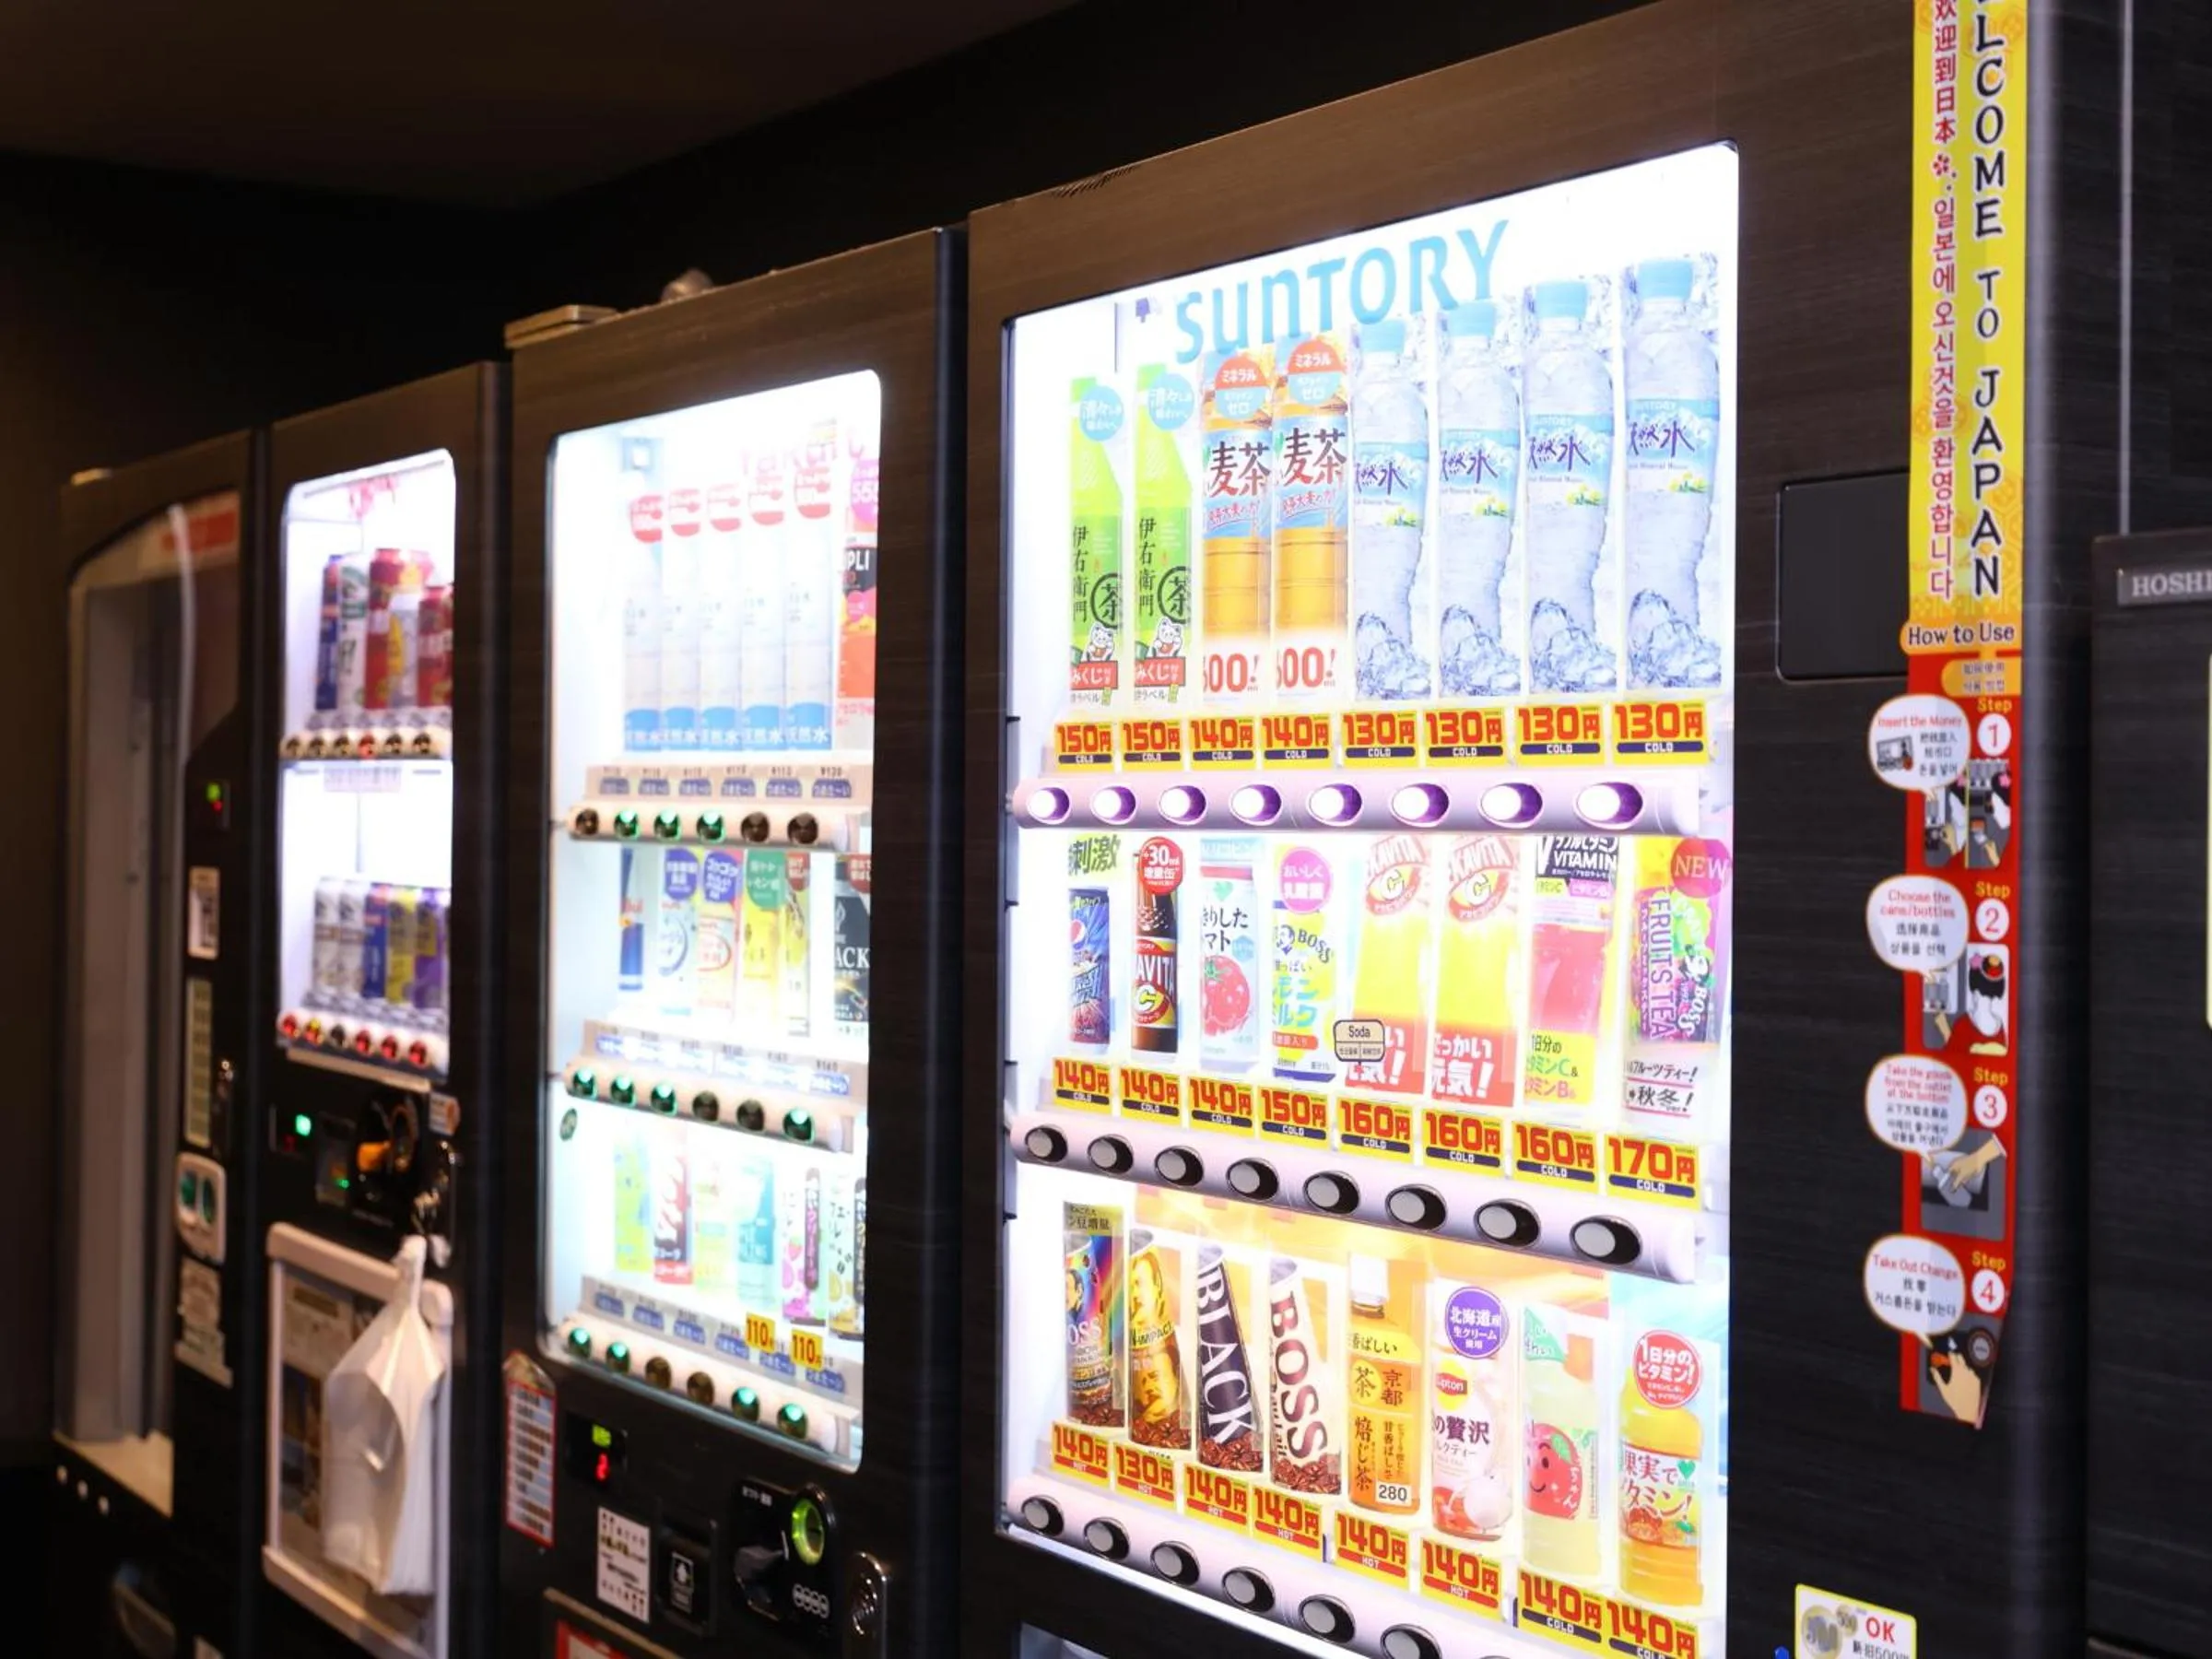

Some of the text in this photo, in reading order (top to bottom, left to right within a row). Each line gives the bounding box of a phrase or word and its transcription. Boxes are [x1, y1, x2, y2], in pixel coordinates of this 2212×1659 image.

[1933, 198, 1955, 293] 일본에
[1175, 219, 1509, 364] SUNTORY
[1971, 0, 2006, 596] LCOME TO JAPAN
[1295, 353, 1331, 367] ミネラル
[1209, 441, 1271, 498] 麦茶
[1283, 428, 1347, 486] 麦茶
[1073, 525, 1088, 623] 伊右衛門
[1138, 518, 1157, 617] 伊右衛門
[1909, 622, 2015, 645] How to Use
[1977, 697, 2012, 713] Step
[1192, 720, 1253, 747] 140円
[1263, 717, 1327, 746] 140円
[1344, 713, 1415, 745] 130円
[1427, 712, 1502, 744] 130円
[1518, 708, 1600, 740] 130円
[1616, 703, 1702, 737] 130円
[1058, 725, 1111, 752] 150円
[1124, 723, 1181, 750] 150円
[1546, 744, 1573, 754] COLD
[1644, 741, 1674, 753] COLD
[1988, 724, 1998, 747] 1
[1076, 754, 1094, 764] COLD
[1142, 753, 1162, 762] COLD
[1211, 751, 1234, 761] COLD
[1285, 750, 1308, 759] COLD
[1368, 747, 1392, 758] COLD
[1453, 747, 1477, 757] COLD
[1283, 865, 1324, 877] おいしく
[1554, 851, 1618, 870] VITAMIN
[1675, 855, 1729, 881] NEW
[1976, 881, 2010, 899] Step
[1984, 907, 2000, 933] 2
[1298, 927, 1331, 964] BOSS
[1651, 897, 1676, 1040] FRUITS TEA
[1348, 1025, 1371, 1038] Soda
[1056, 1061, 1110, 1094] 140円
[1122, 1070, 1179, 1104] 140円
[1974, 1067, 2008, 1085] Step
[1073, 1092, 1092, 1103] COLD
[1141, 1101, 1160, 1113] COLD
[1190, 1079, 1252, 1115] 140円
[1261, 1089, 1326, 1127] 150円
[1983, 1094, 1997, 1119] 3
[1211, 1112, 1232, 1125] COLD
[1282, 1124, 1304, 1136] COLD
[1341, 1101, 1410, 1140] 160円
[1363, 1137, 1386, 1150] COLD
[1426, 1113, 1500, 1154] 160円
[1517, 1124, 1594, 1168] 160円
[1449, 1150, 1475, 1163] COLD
[1608, 1139, 1695, 1183] 170円
[1541, 1164, 1567, 1178] COLD
[1636, 1180, 1665, 1194] COLD
[1874, 1254, 1959, 1280] Take Out Change
[1971, 1251, 2006, 1271] Step
[1981, 1279, 1996, 1304] 4
[1453, 1326, 1497, 1341] 生クリーム
[1199, 1263, 1254, 1444] BLACK
[1641, 1335, 1693, 1364] 1日分の
[1271, 1290, 1328, 1459] BOSS
[1354, 1366, 1376, 1398] 茶
[1638, 1360, 1696, 1385] ビタミン!
[1380, 1369, 1404, 1406] 京都
[1054, 1425, 1108, 1467] 140円
[1354, 1416, 1373, 1491] 焙じ茶
[1116, 1445, 1173, 1490] 130円
[1623, 1450, 1677, 1485] 果実で
[1187, 1466, 1247, 1512] 140円
[1378, 1484, 1407, 1501] 280
[1254, 1488, 1319, 1536] 140円
[1337, 1513, 1406, 1565] 140円
[1362, 1555, 1379, 1568] HOT
[1423, 1539, 1499, 1595] 140円
[1451, 1585, 1470, 1599] HOT
[1521, 1571, 1602, 1630] 140円
[1547, 1617, 1574, 1634] COLD
[1865, 1617, 1895, 1643] OK
